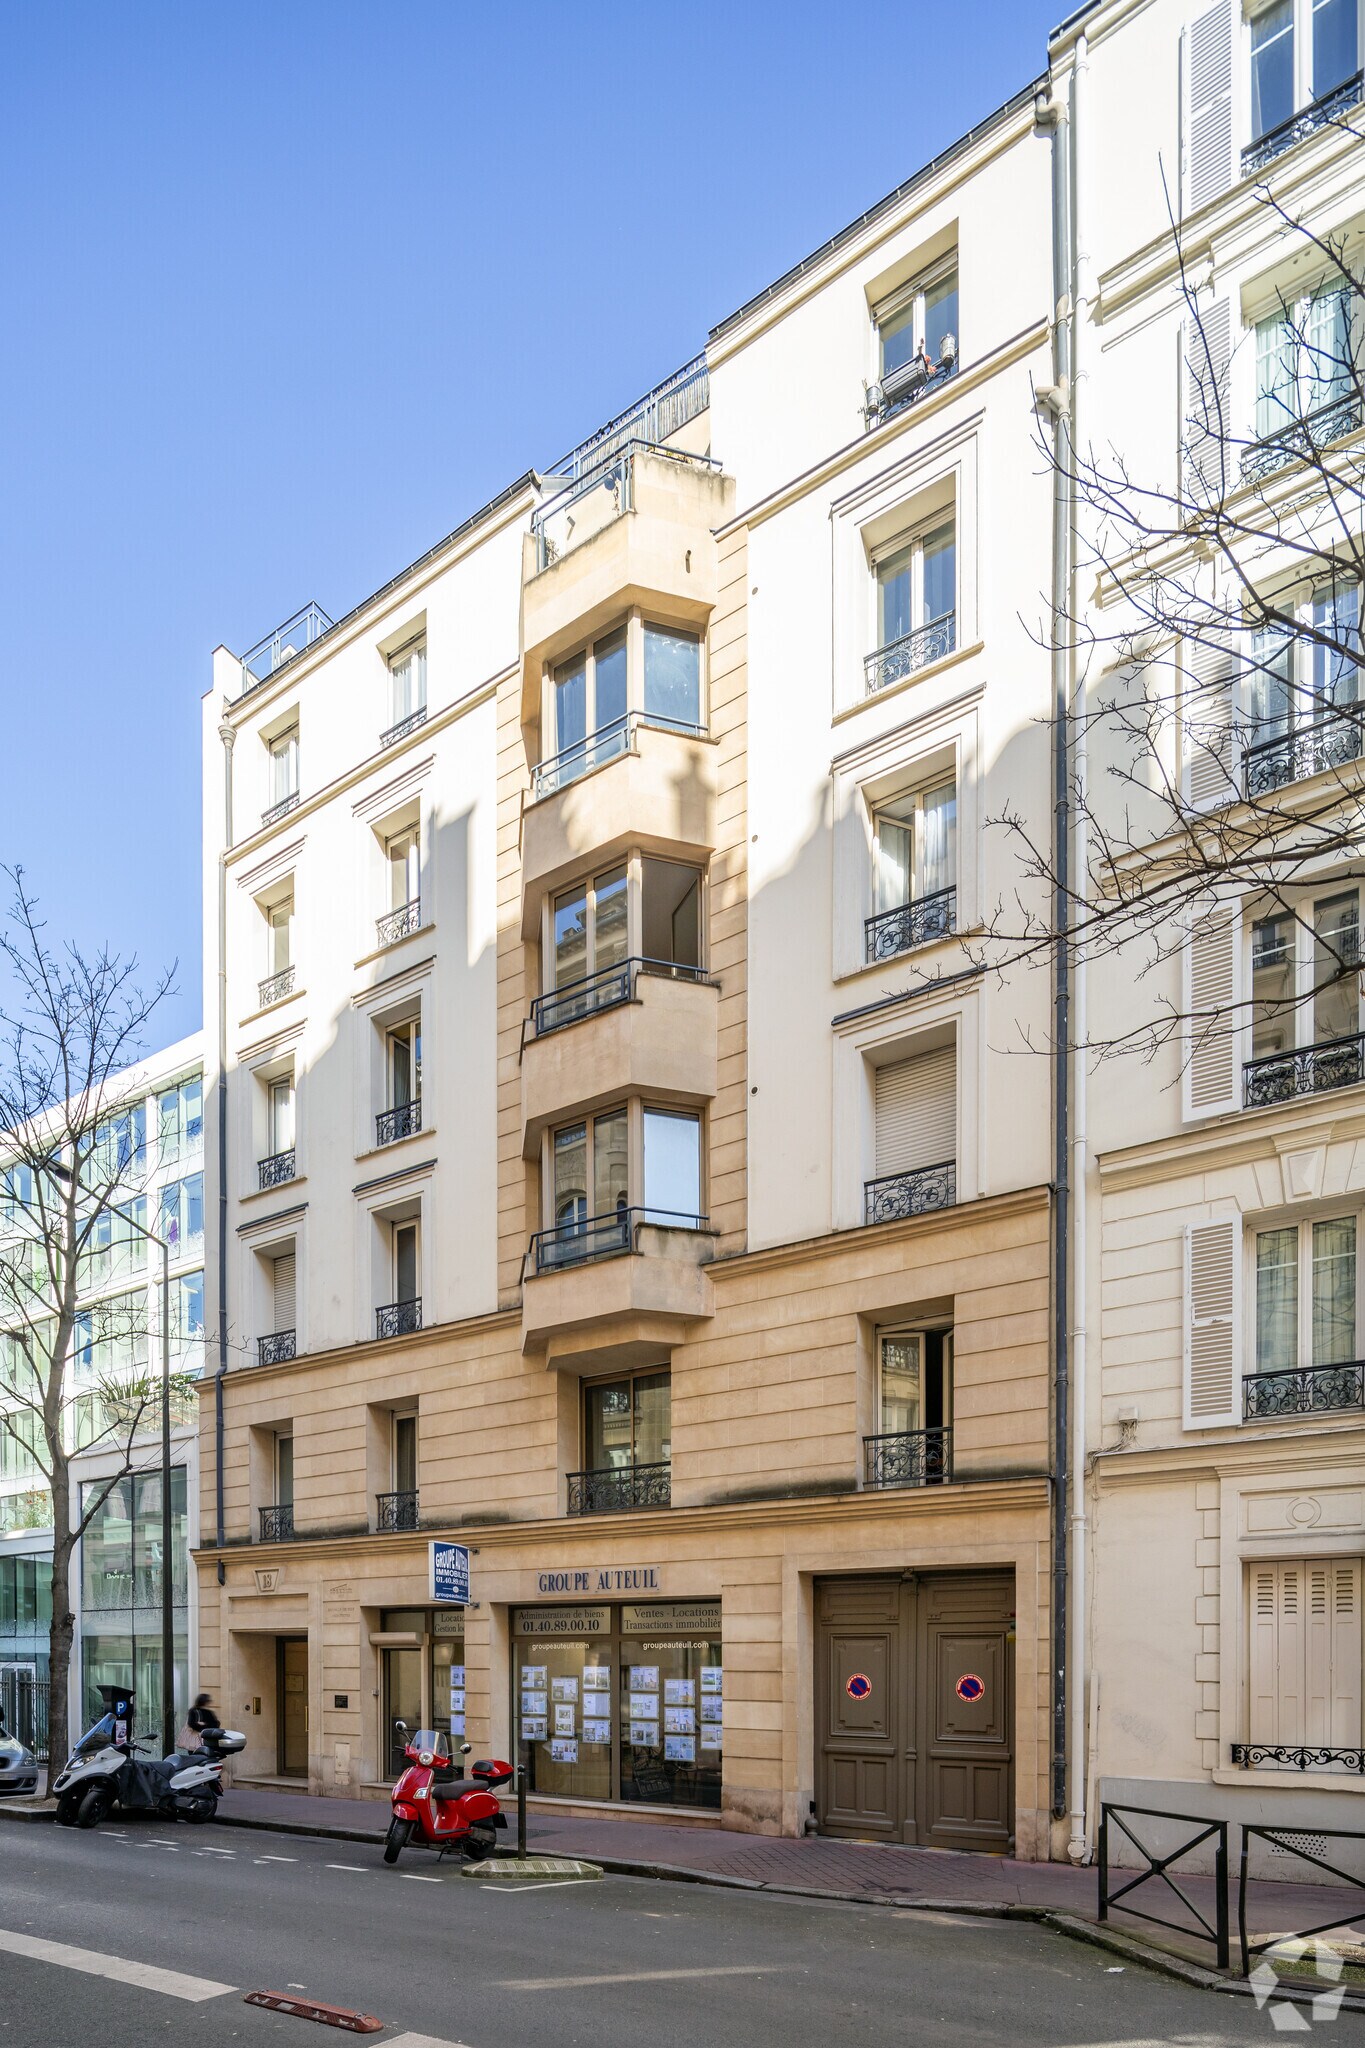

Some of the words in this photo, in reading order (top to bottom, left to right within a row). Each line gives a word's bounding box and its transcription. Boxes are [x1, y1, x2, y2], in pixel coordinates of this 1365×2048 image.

[435, 1548, 455, 1570] GROUPE
[539, 1572, 589, 1592] GROUPE
[597, 1569, 658, 1590] AUTEUIL
[519, 1611, 571, 1620] Administration
[573, 1609, 582, 1619] de
[585, 1608, 605, 1618] biens
[634, 1608, 664, 1618] Ventes
[672, 1607, 719, 1617] Locations
[434, 1623, 457, 1633] Gestion
[523, 1619, 600, 1632] 01.40.89.00.10
[624, 1619, 673, 1630] Transactions
[531, 1642, 590, 1651] groupeauteuil.com
[642, 1641, 709, 1650] groupeauteuil.com
[117, 1702, 124, 1712] P
